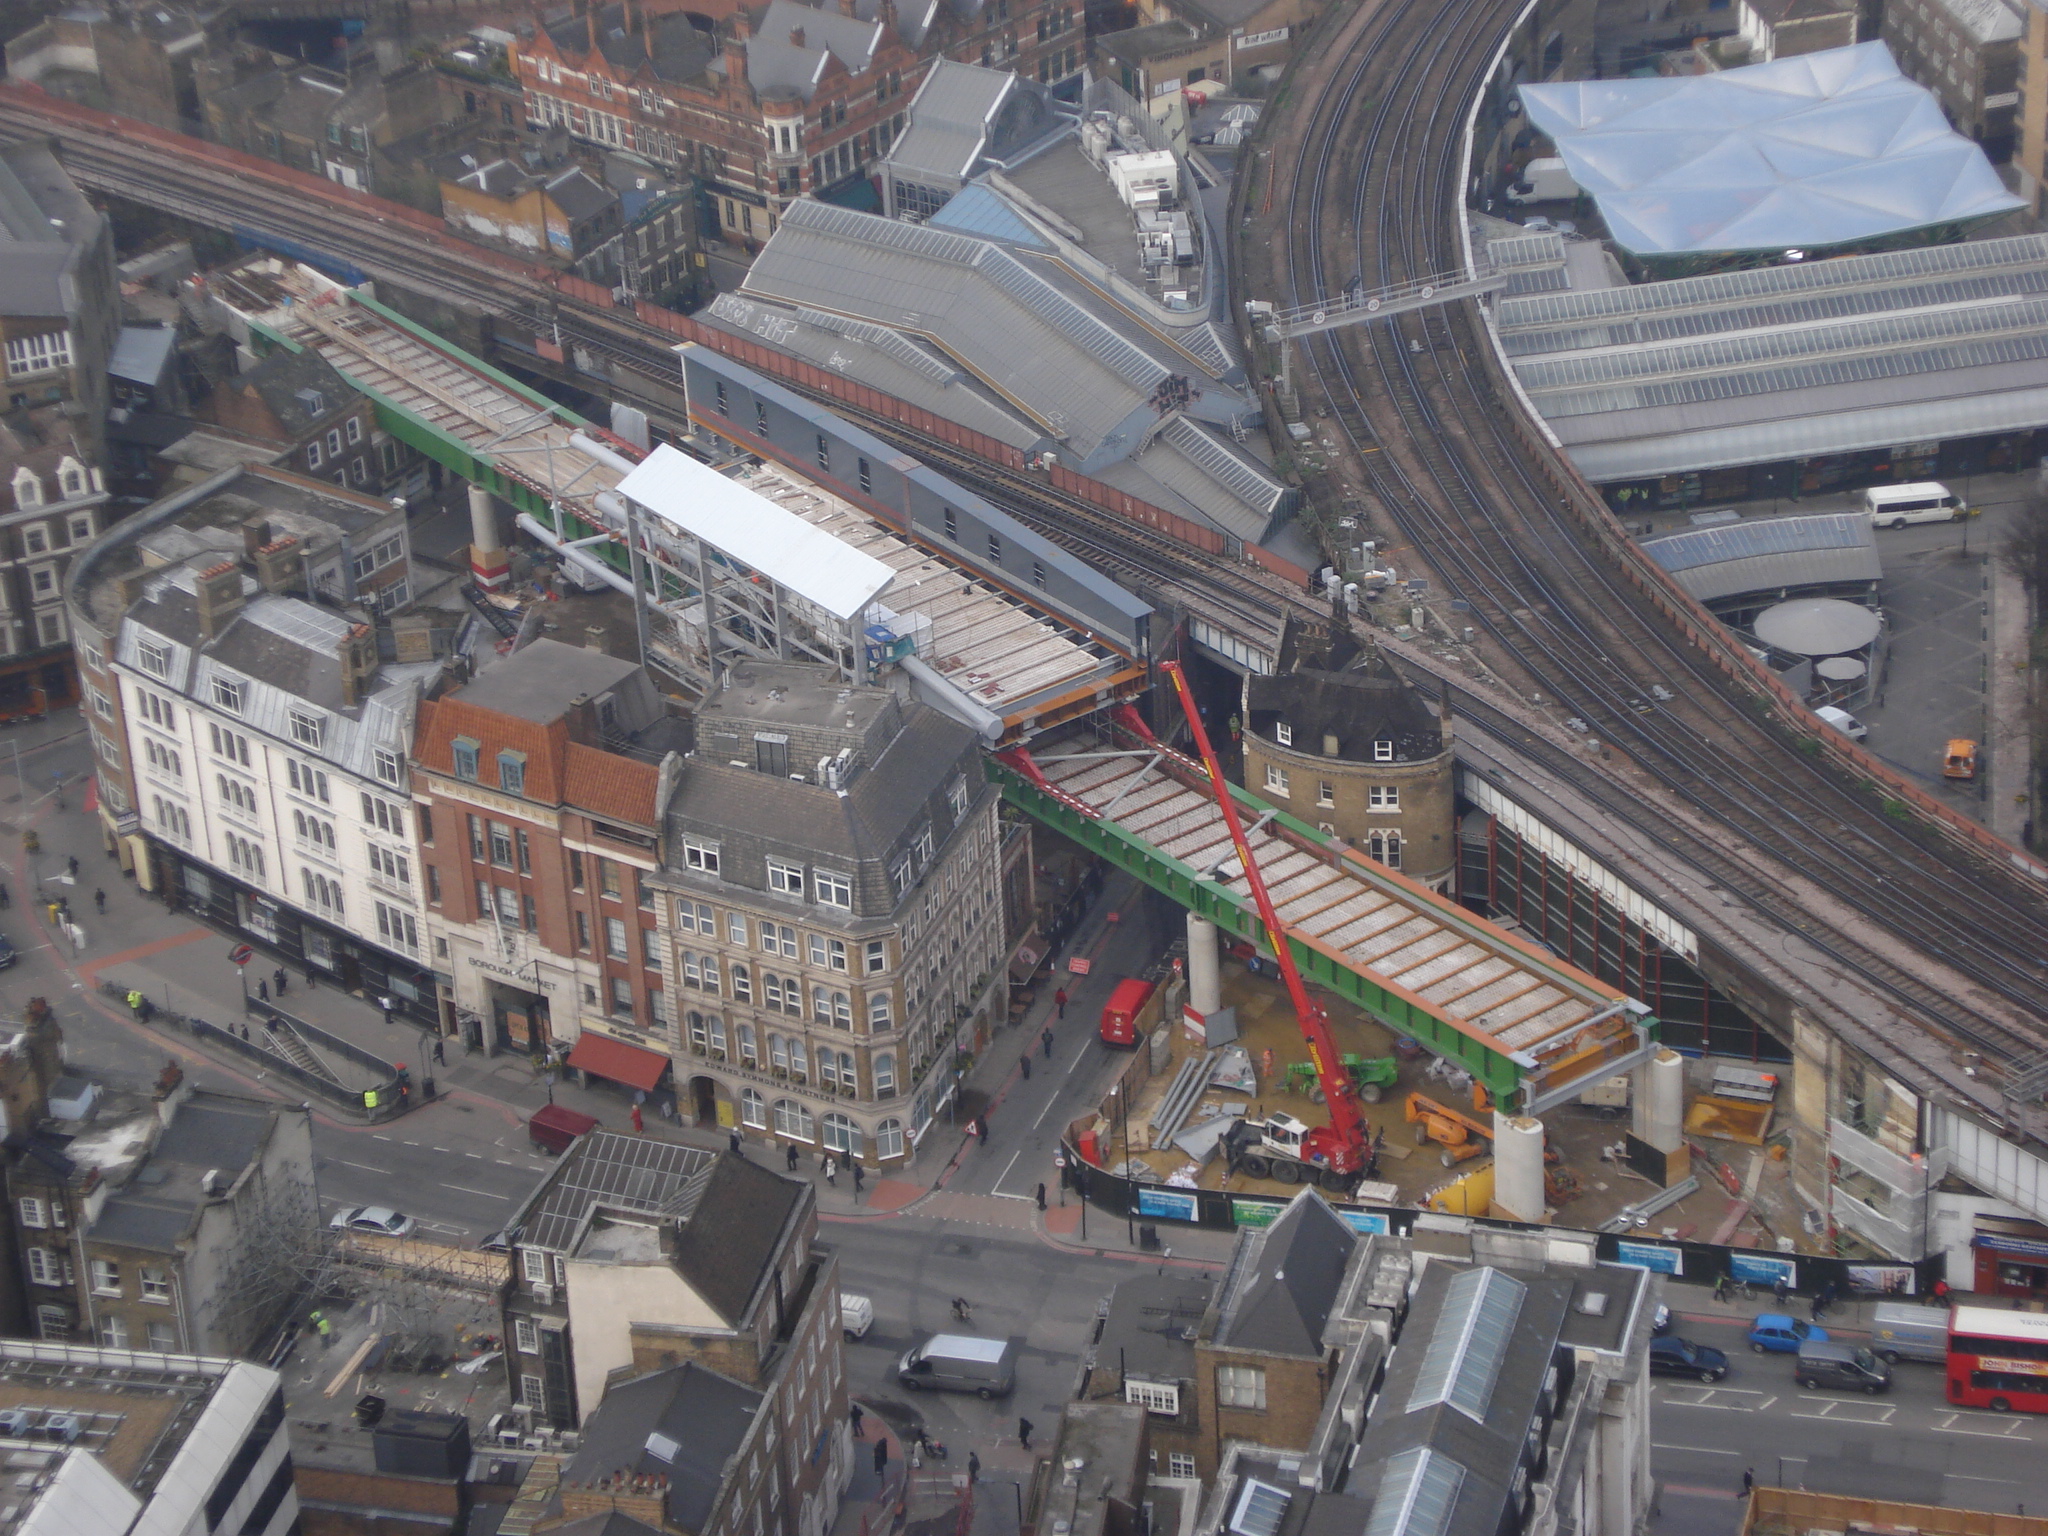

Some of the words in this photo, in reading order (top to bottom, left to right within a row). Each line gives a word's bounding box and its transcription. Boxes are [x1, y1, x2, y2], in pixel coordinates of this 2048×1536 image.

[467, 956, 513, 977] BOROUGH
[518, 973, 557, 991] MARKET
[705, 1061, 739, 1076] EDWARD
[742, 1071, 782, 1089] SYMMONS
[793, 1086, 836, 1103] PARTNERS
[1983, 1359, 2007, 1367] JOHN
[2010, 1361, 2044, 1370] BISHOP
